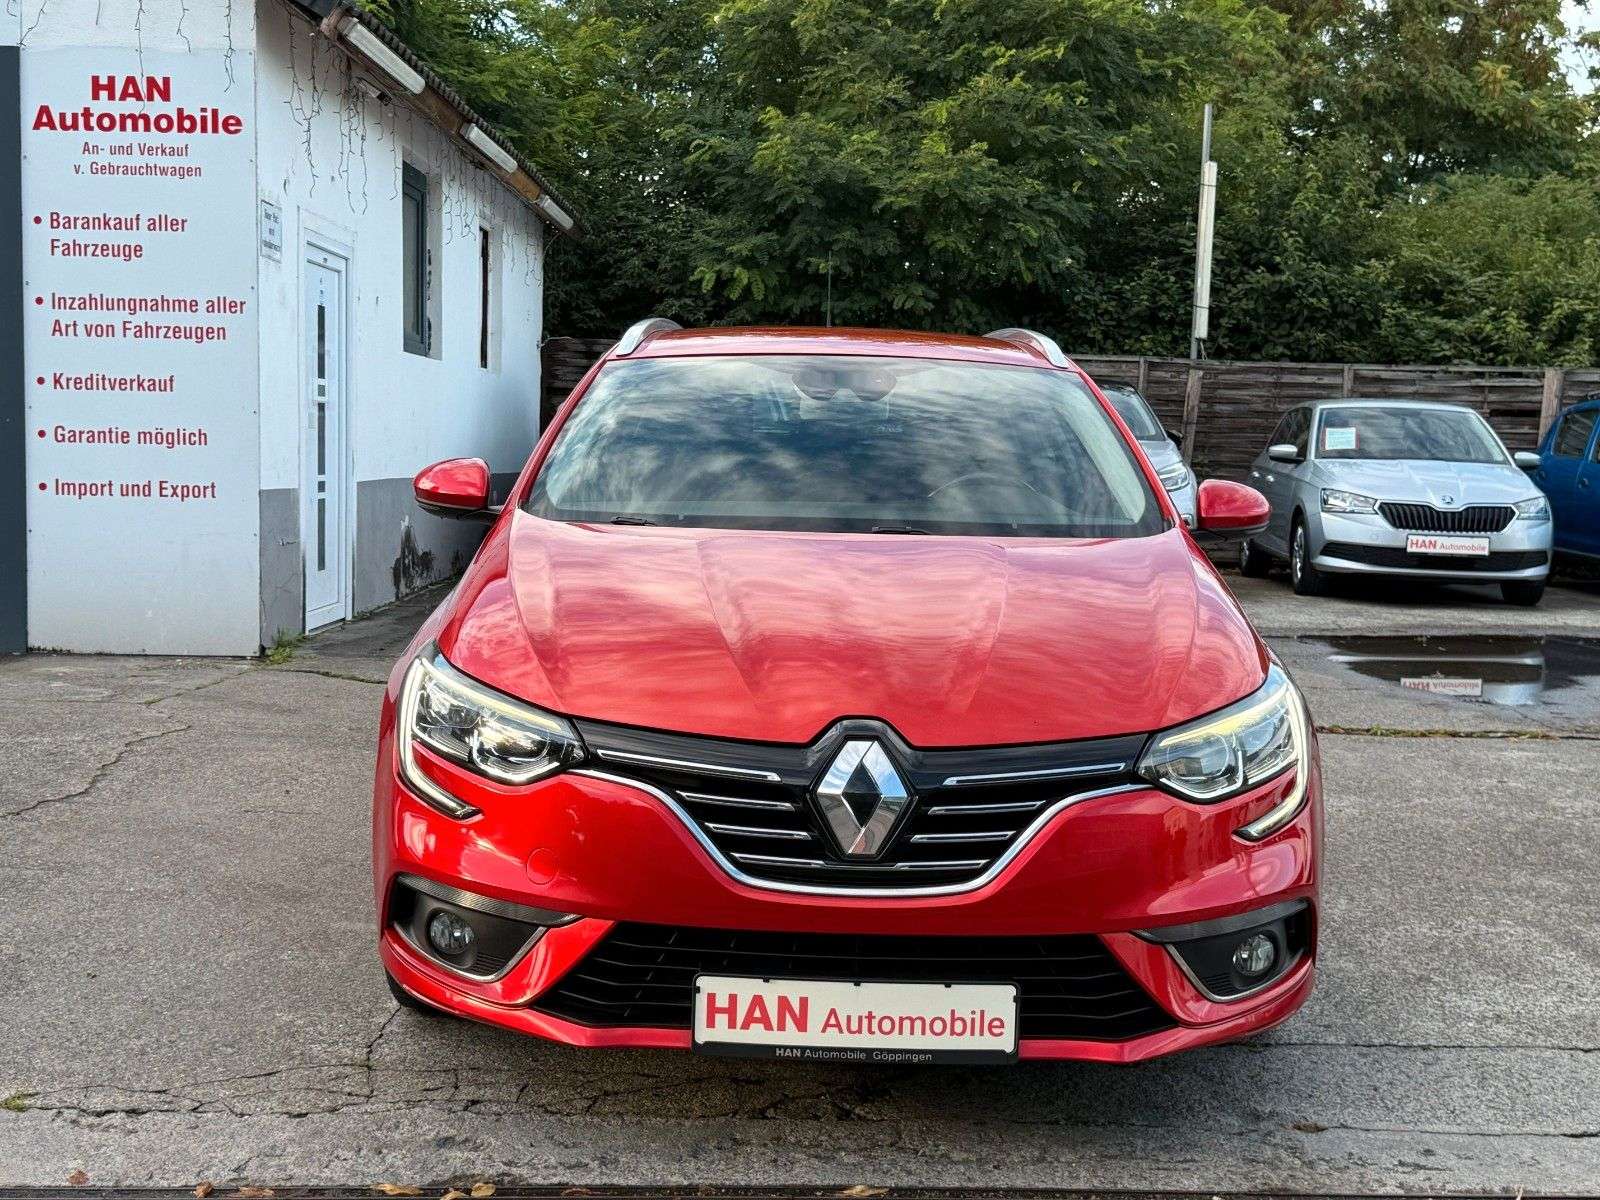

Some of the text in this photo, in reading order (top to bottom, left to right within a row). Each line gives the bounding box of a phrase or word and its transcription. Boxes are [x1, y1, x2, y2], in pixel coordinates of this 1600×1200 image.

[91, 75, 171, 103] HAN
[32, 105, 242, 134] Automobile
[82, 142, 188, 157] An- und Verkauf
[74, 162, 201, 179] v. Gebrauchtwagen
[50, 212, 187, 232] Barankauf aller
[51, 239, 143, 262] Fahrzeuge
[52, 293, 246, 315] Inzahlungnahme aller
[52, 320, 226, 344] Art von Fahrzeugen
[54, 373, 174, 392] Kreditverkauf
[54, 426, 207, 449] Garantie möglich
[56, 479, 216, 502] Import und Export
[1410, 539, 1486, 552] HAN Automobile
[706, 993, 1004, 1037] HAN Automobile
[775, 1048, 932, 1062] HAN Automobile Göppingen
